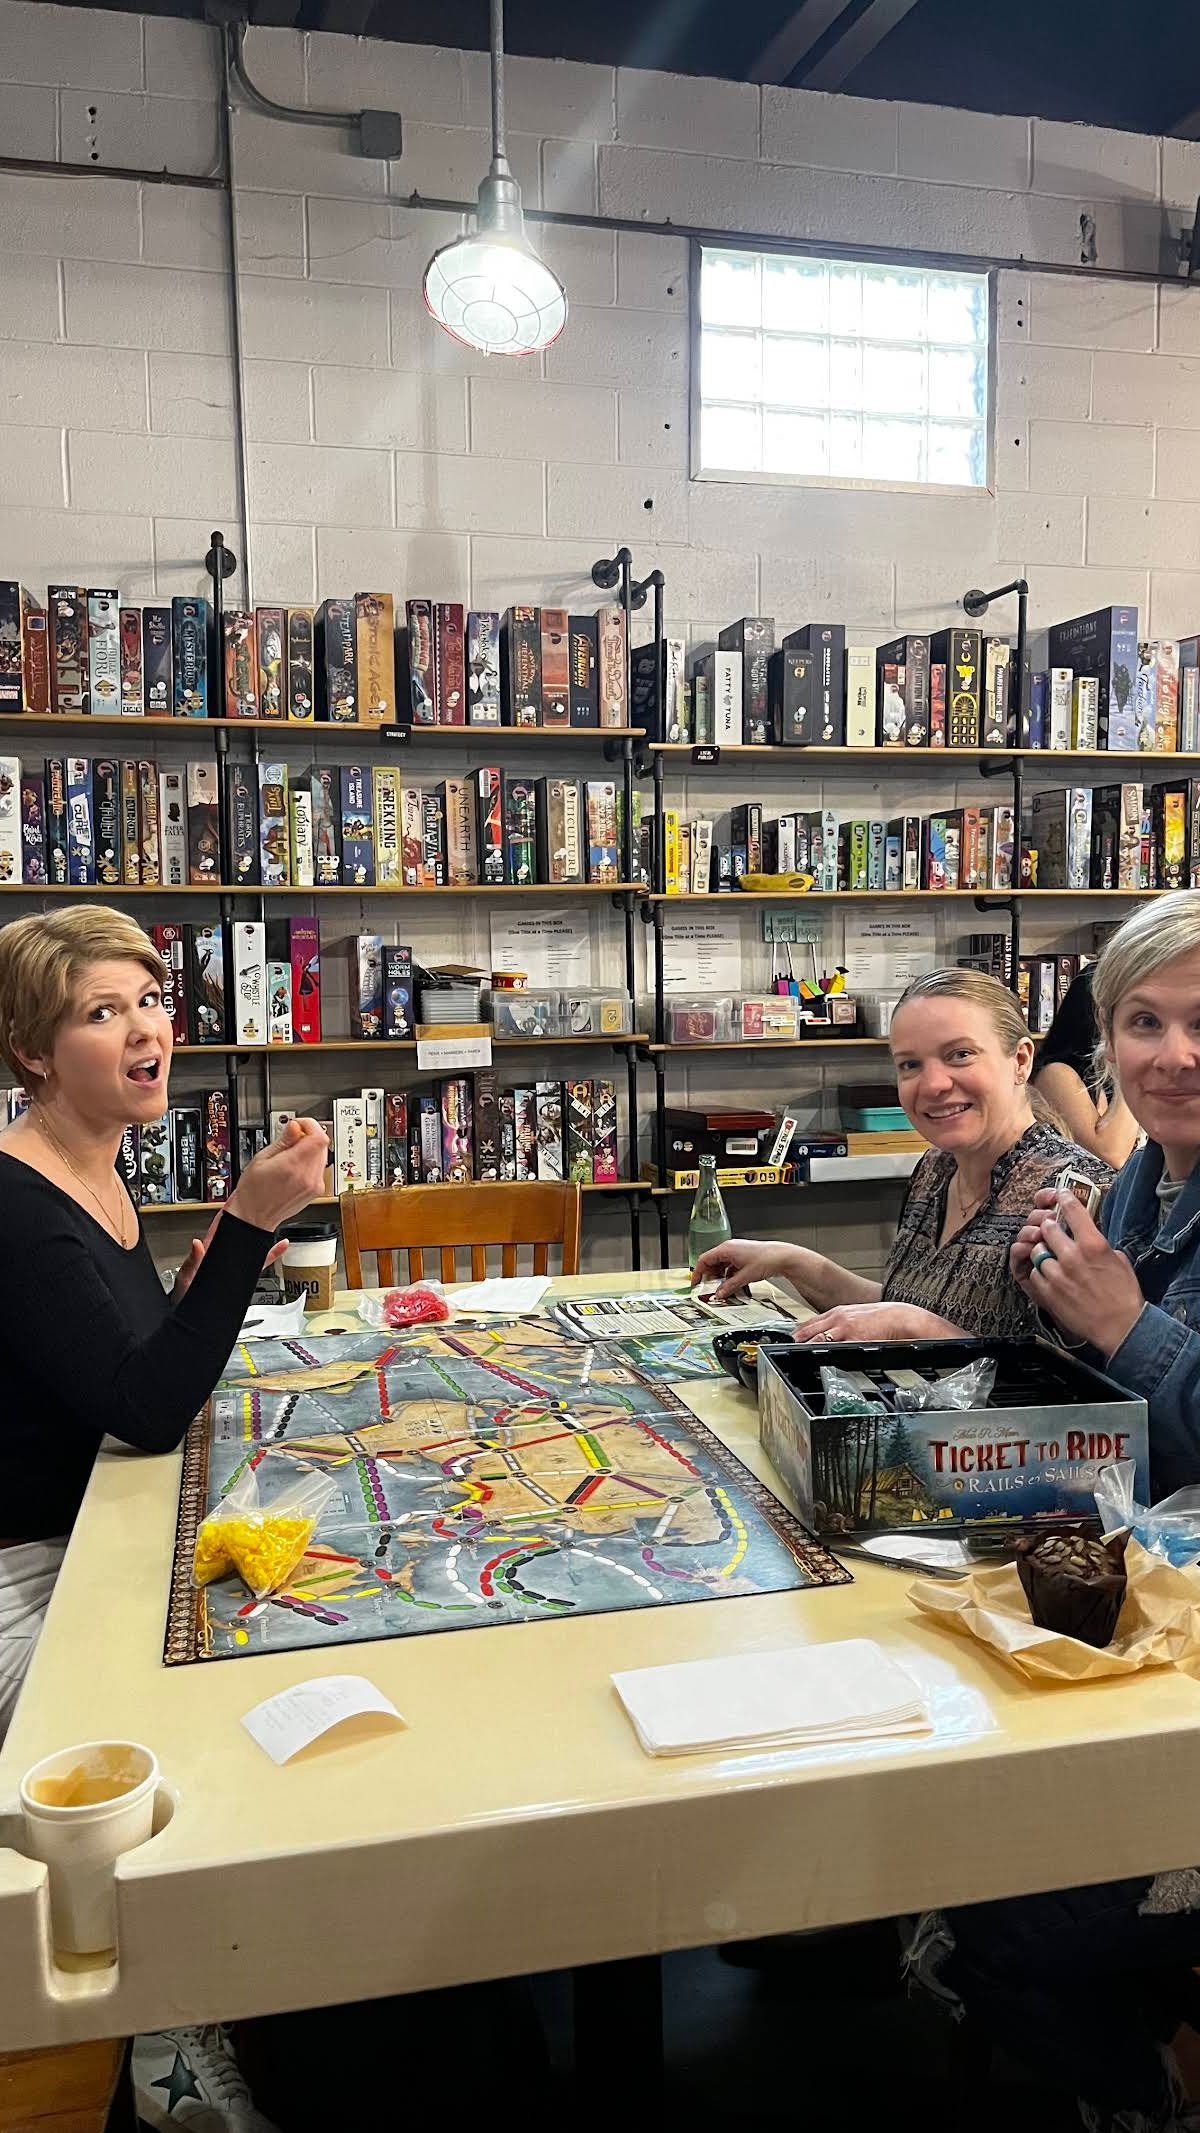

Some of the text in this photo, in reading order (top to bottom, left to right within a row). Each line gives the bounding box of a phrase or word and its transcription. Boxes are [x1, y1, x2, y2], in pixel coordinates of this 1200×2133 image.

[184, 629, 197, 685] MYSTERIUM
[521, 642, 530, 690] TIEFENTHAL
[1087, 680, 1097, 712] DOODLE
[51, 770, 64, 815] PANDEMIC
[267, 791, 282, 814] TINY
[1129, 788, 1139, 822] SALOON
[75, 804, 84, 835] CURE
[237, 803, 245, 848] EUPHRATES
[244, 813, 252, 838] TIGRIS
[294, 806, 308, 847] topiary
[383, 788, 396, 849] TREKKING
[459, 788, 471, 852] UNEARTH
[566, 790, 578, 877] VITICULTURE
[1004, 953, 1012, 979] DAYS
[252, 973, 261, 1006] WHISTLE
[208, 1096, 220, 1137] Smashers
[218, 1104, 228, 1128] Spell
[340, 1108, 361, 1116] MAZE
[424, 1117, 432, 1153] GROUNDS
[181, 1136, 190, 1172] BASE
[927, 1430, 1132, 1473] TICKET TO RIDE
[968, 1475, 1025, 1494] RAILS
[1045, 1466, 1096, 1484] SAILS
